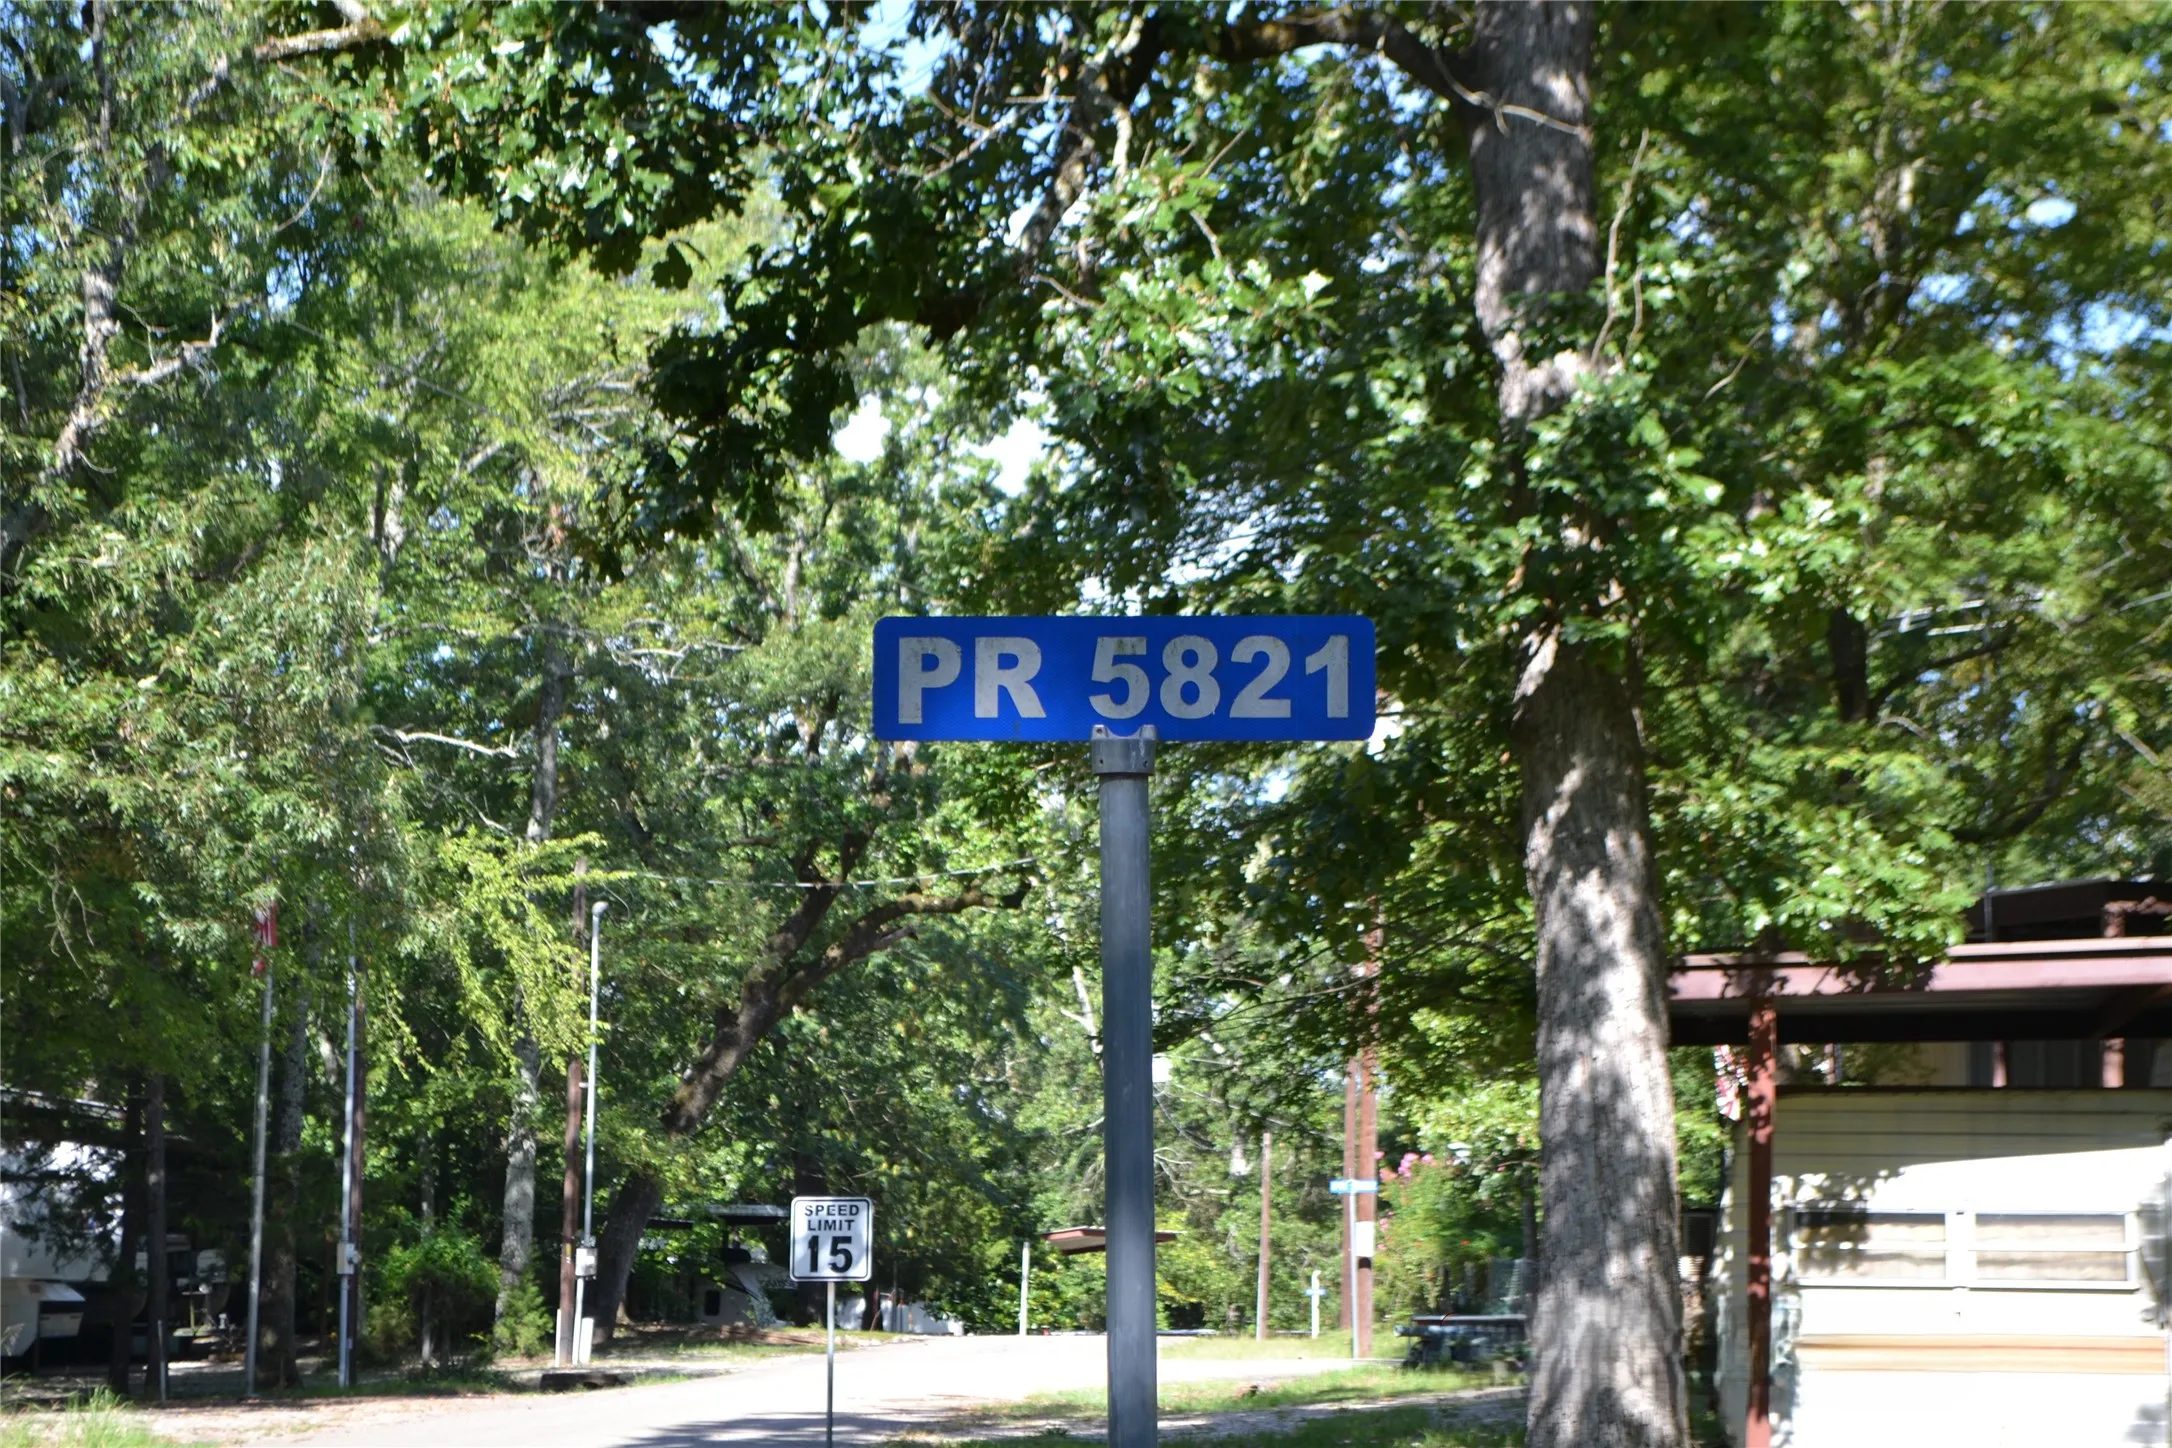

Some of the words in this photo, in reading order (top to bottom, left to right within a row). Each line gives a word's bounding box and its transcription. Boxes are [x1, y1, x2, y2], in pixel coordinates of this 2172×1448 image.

[898, 636, 1047, 725] PR
[1089, 634, 1350, 721] 5821
[804, 1204, 860, 1217] SPEED
[807, 1219, 855, 1232] LIMIT
[808, 1235, 853, 1274] 15
